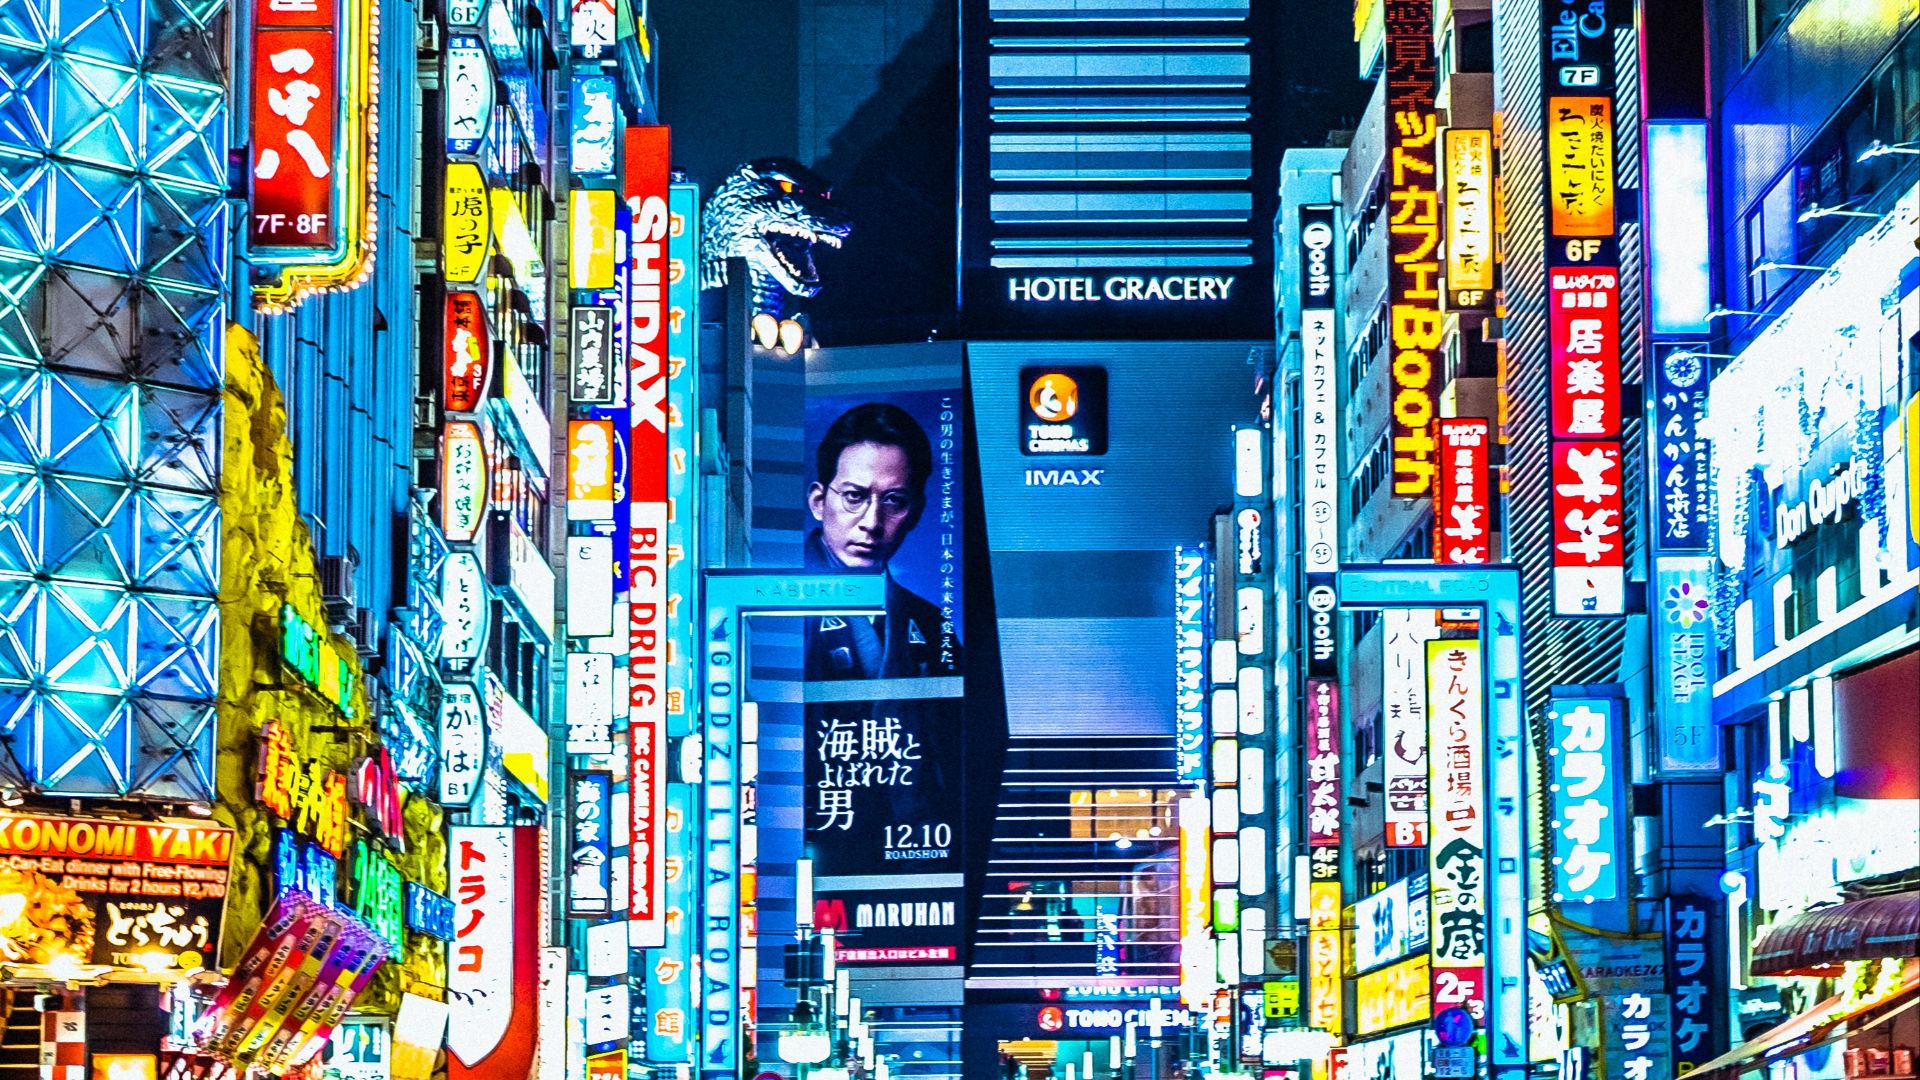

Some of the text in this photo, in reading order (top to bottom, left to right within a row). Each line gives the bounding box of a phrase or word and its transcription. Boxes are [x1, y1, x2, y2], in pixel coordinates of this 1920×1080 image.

[1579, 0, 1606, 38] Ca
[1565, 70, 1594, 83] 7F
[455, 140, 472, 150] 5F
[1567, 240, 1601, 262] 6F
[1009, 277, 1234, 301] HOTEL GRACERY
[1458, 291, 1484, 306] 6F
[626, 196, 669, 433] SHIDAX
[1025, 469, 1101, 486] IMAX
[1776, 501, 1807, 550] Don
[632, 527, 656, 707] BIC DRUG
[448, 658, 470, 671] 1F
[817, 718, 922, 761] 海賊と
[1674, 726, 1704, 746] 5F
[817, 762, 913, 788] よばれた
[816, 789, 855, 831] 男
[1562, 706, 1611, 892] カラオケ
[147, 827, 232, 862] YAKI
[710, 652, 732, 1026] GODZILLA ROAD
[884, 824, 951, 849] 12.10
[885, 850, 949, 860] ROADSHOW
[1312, 847, 1338, 862] 4F
[66, 861, 110, 875] dinner
[112, 863, 141, 877] with
[143, 864, 227, 884] Free-Flowing
[1312, 863, 1338, 878] 3F
[63, 876, 107, 891] Drinks
[109, 879, 129, 893] for
[130, 881, 141, 894] 2
[142, 881, 181, 896] hours
[457, 841, 486, 972] トラノコ
[856, 902, 955, 927] MARUHAN
[1436, 971, 1475, 1003] 2F
[1675, 906, 1708, 1053] カラオケ
